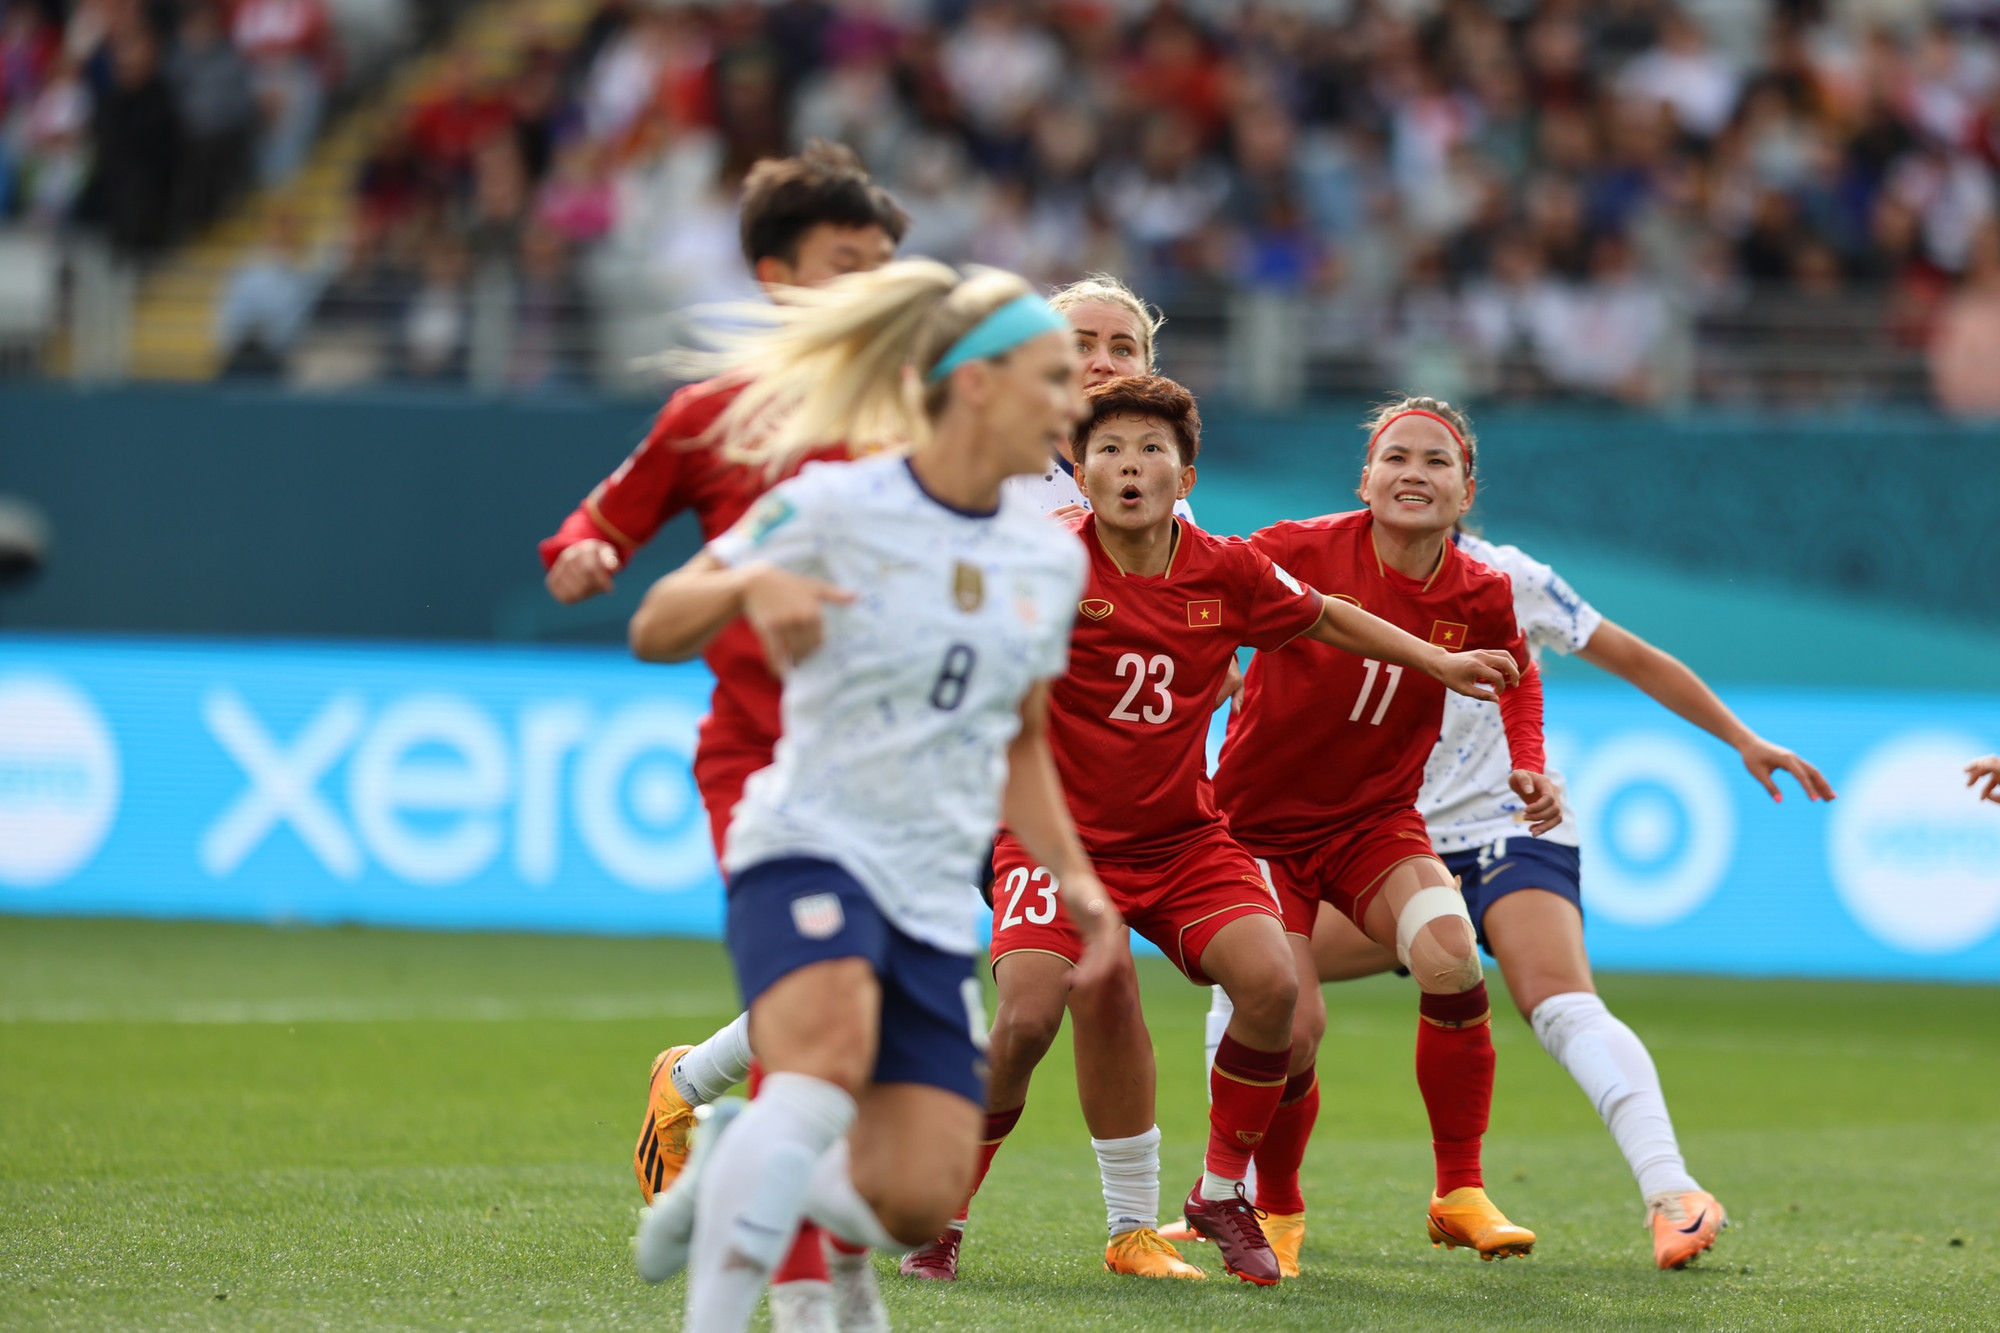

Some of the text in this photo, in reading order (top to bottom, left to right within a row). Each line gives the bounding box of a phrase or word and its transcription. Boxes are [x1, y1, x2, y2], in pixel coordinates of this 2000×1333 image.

[931, 644, 976, 711] 8
[1109, 653, 1174, 724] 23
[1349, 658, 1403, 726] 11
[203, 687, 720, 890] xero
[1000, 866, 1060, 931] 23
